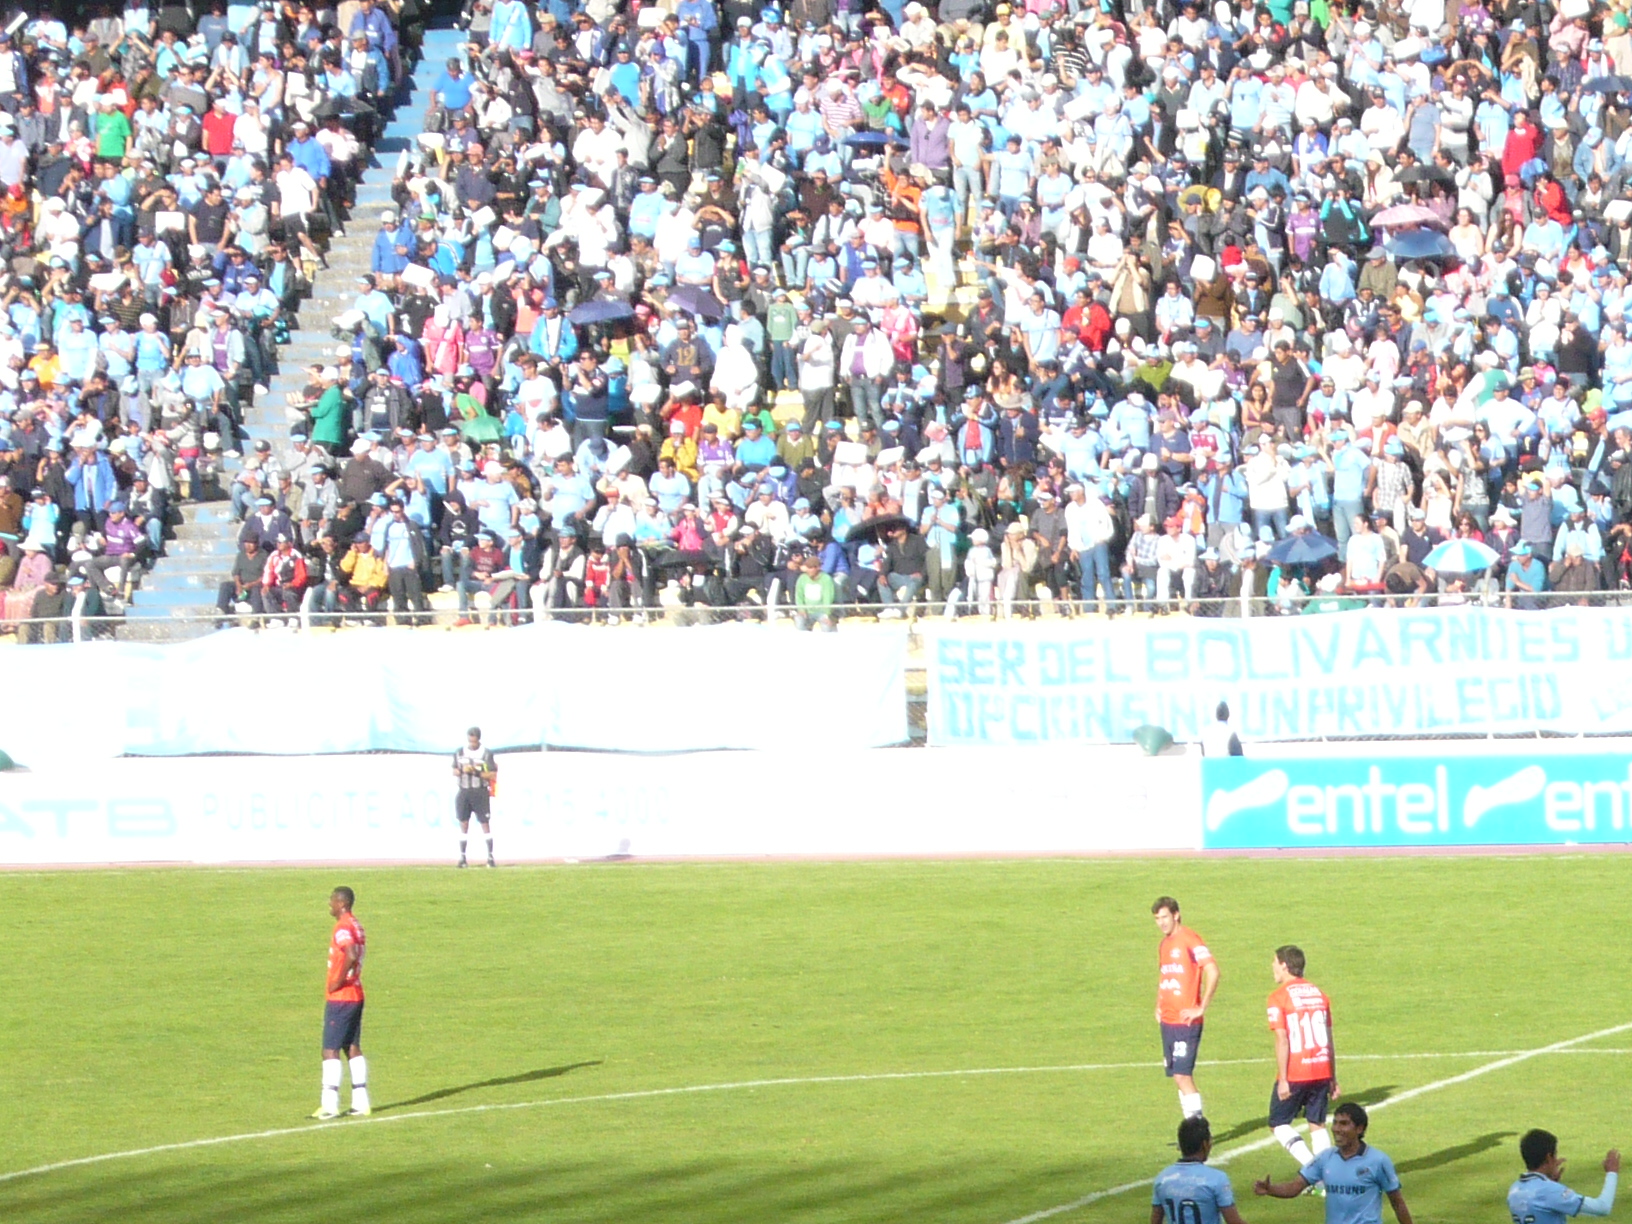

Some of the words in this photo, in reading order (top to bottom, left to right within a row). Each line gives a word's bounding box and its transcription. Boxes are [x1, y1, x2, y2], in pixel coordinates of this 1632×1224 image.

[936, 635, 1027, 687] SER
[1036, 636, 1133, 687] DEL
[1144, 613, 1444, 684] BOLIVAR
[1514, 615, 1581, 664] ES
[1239, 686, 1300, 737] UN
[1306, 671, 1563, 734] PRIVILEGIO
[1286, 764, 1449, 834] entel
